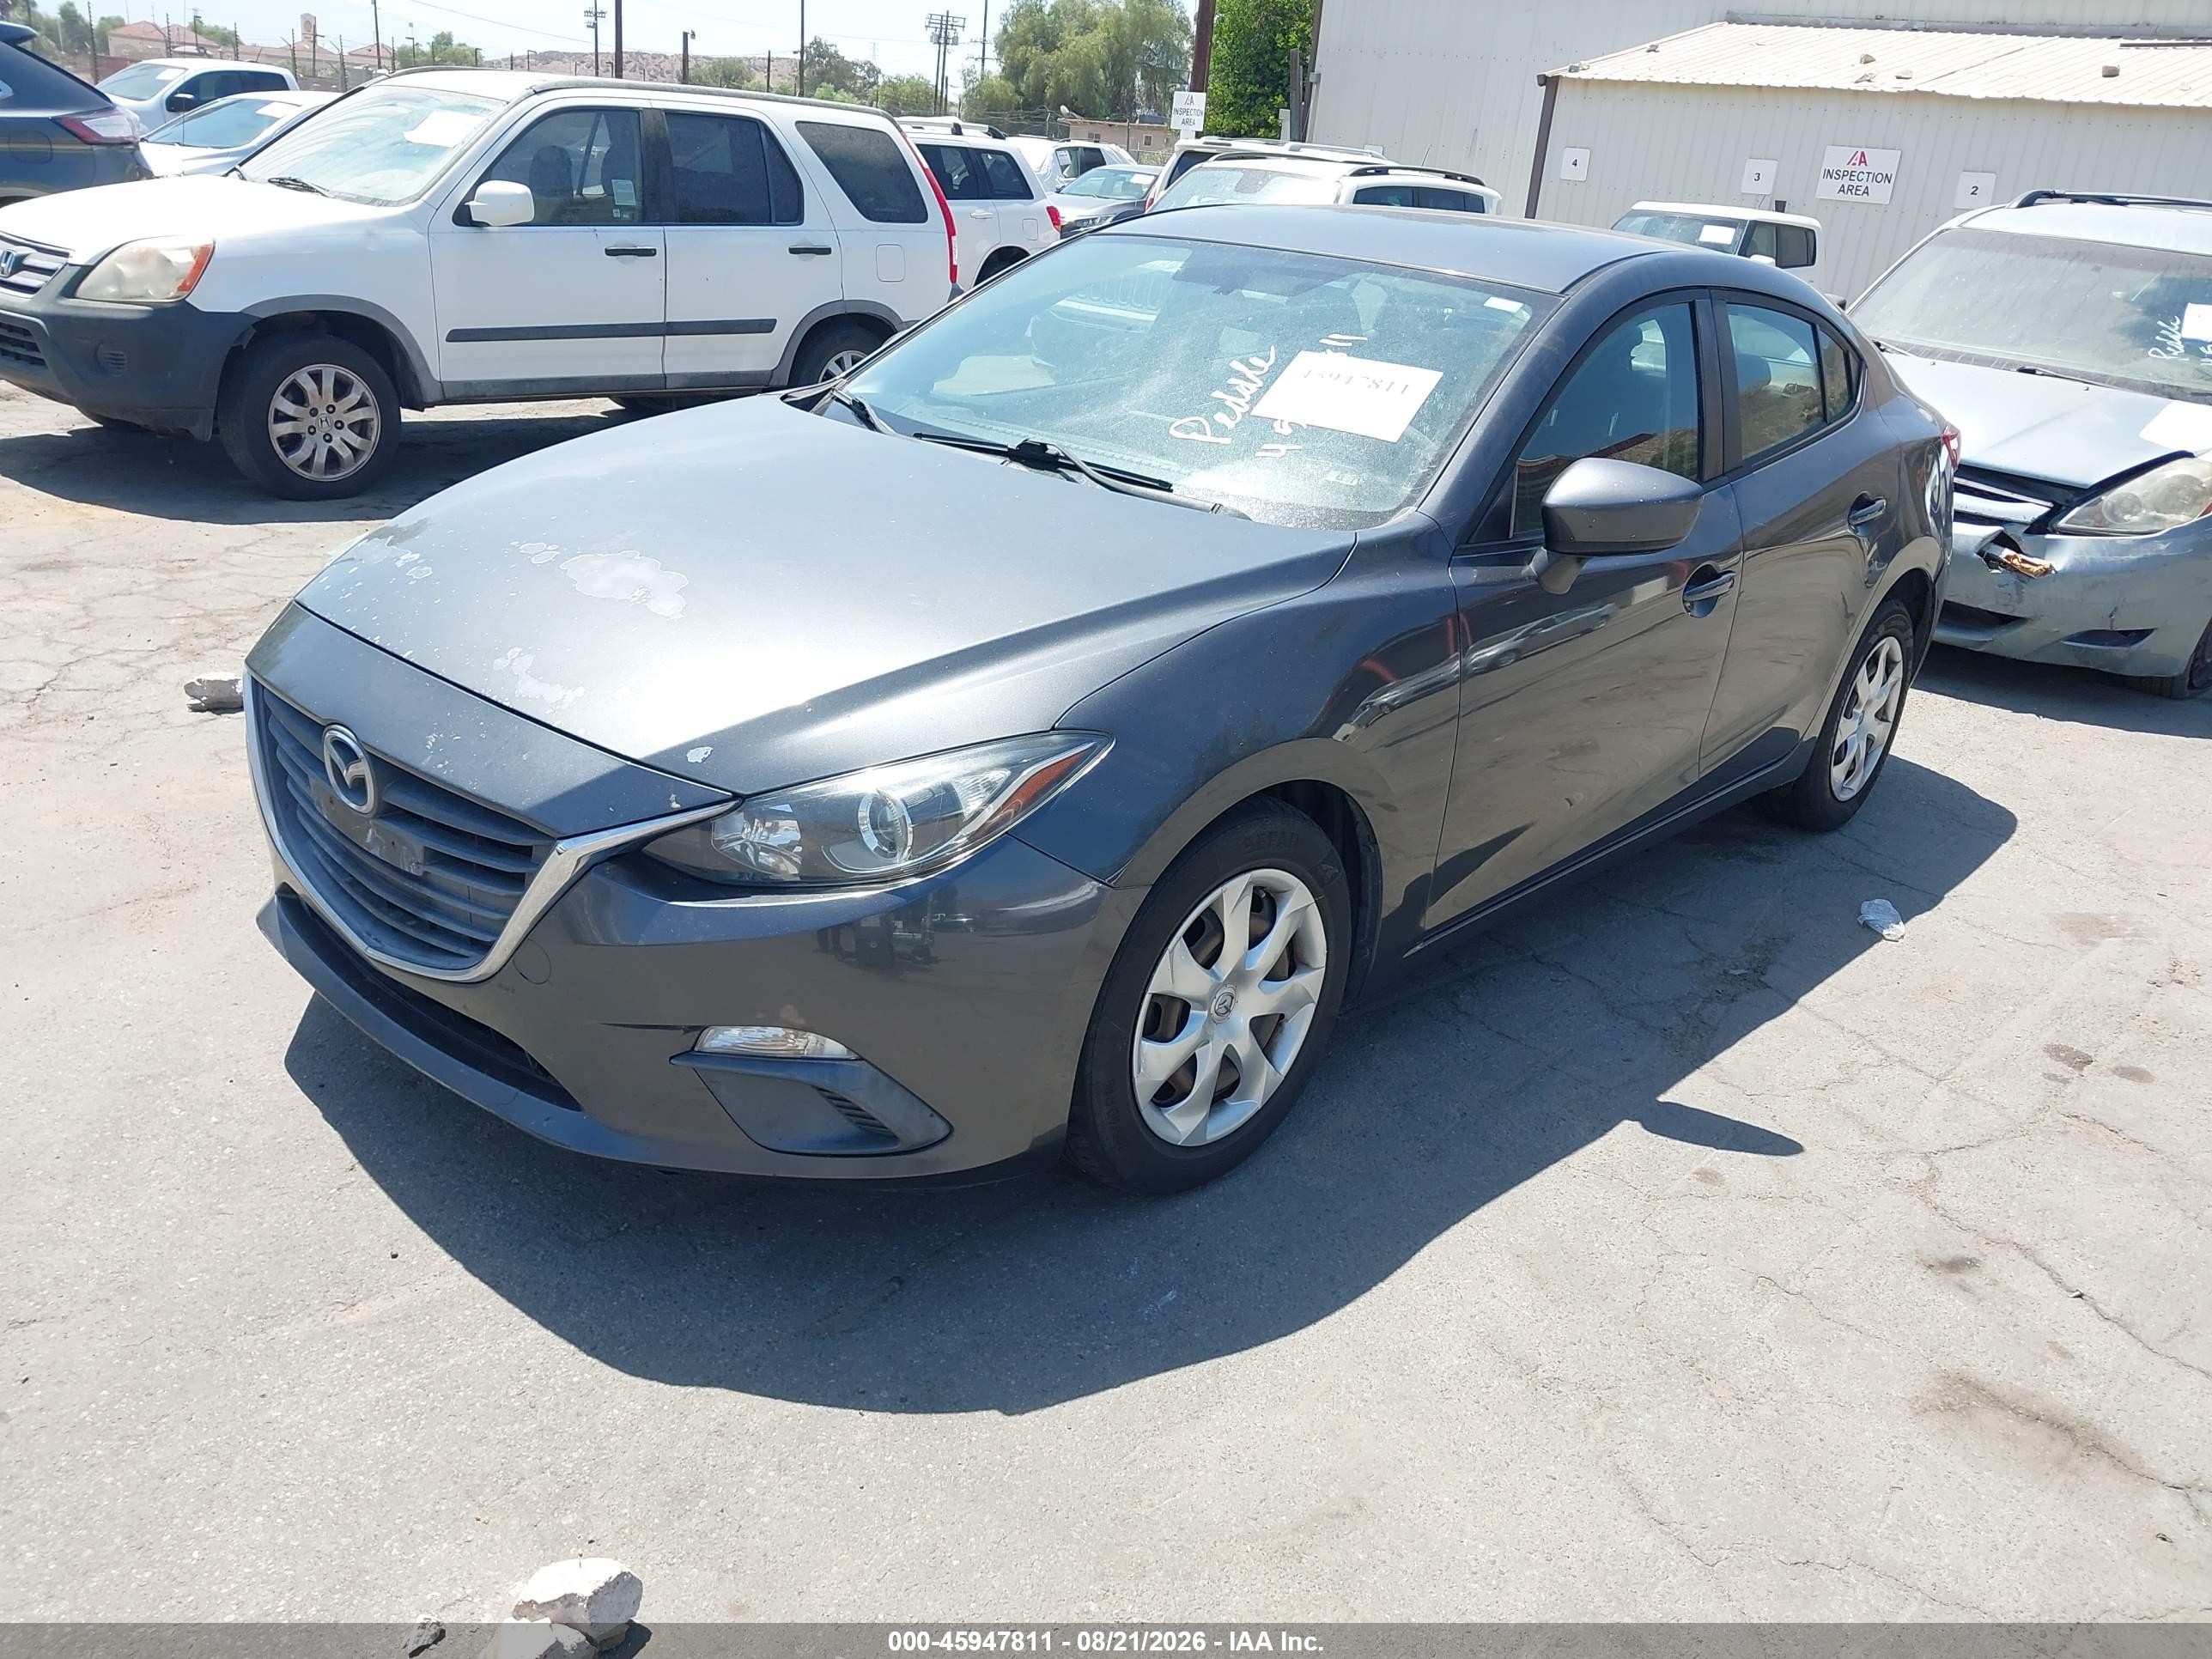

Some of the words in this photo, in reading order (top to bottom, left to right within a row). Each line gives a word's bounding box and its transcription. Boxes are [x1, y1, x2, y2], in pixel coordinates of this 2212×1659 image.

[1173, 107, 1204, 117] INSPECTION
[1181, 118, 1196, 126] AREA
[1571, 158, 1577, 167] 4
[1753, 172, 1760, 182] 3
[1822, 168, 1893, 184] INSPECTION
[1837, 184, 1870, 197] AREA
[1970, 185, 1979, 196] 2
